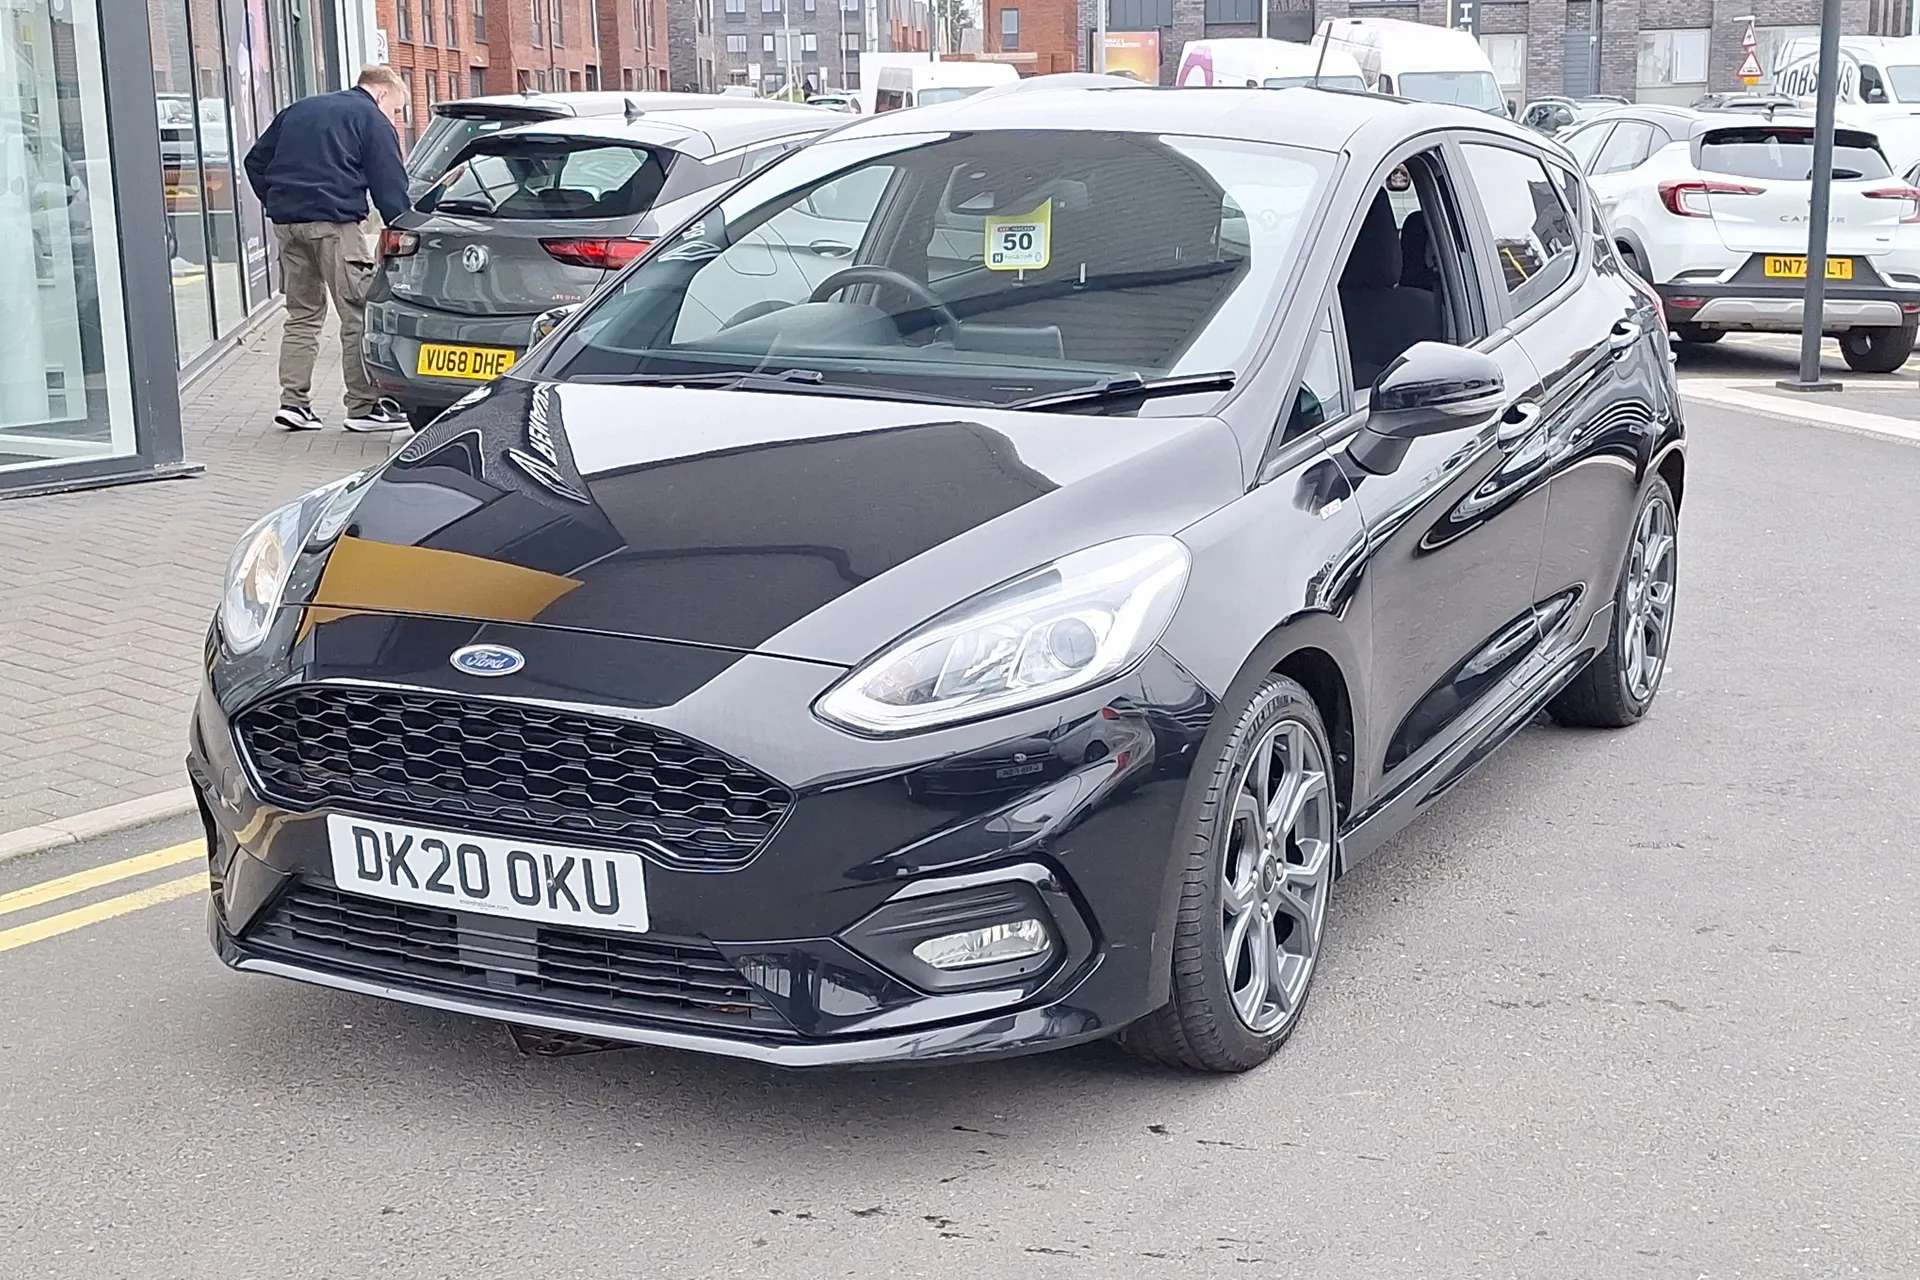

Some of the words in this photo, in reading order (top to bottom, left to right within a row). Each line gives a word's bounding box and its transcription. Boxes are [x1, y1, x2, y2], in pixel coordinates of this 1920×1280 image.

[1003, 232, 1033, 251] 50
[427, 349, 467, 373] VU68
[472, 352, 507, 375] DHE
[465, 650, 510, 669] Ford
[351, 825, 490, 899] DK20
[506, 849, 620, 915] OKU
